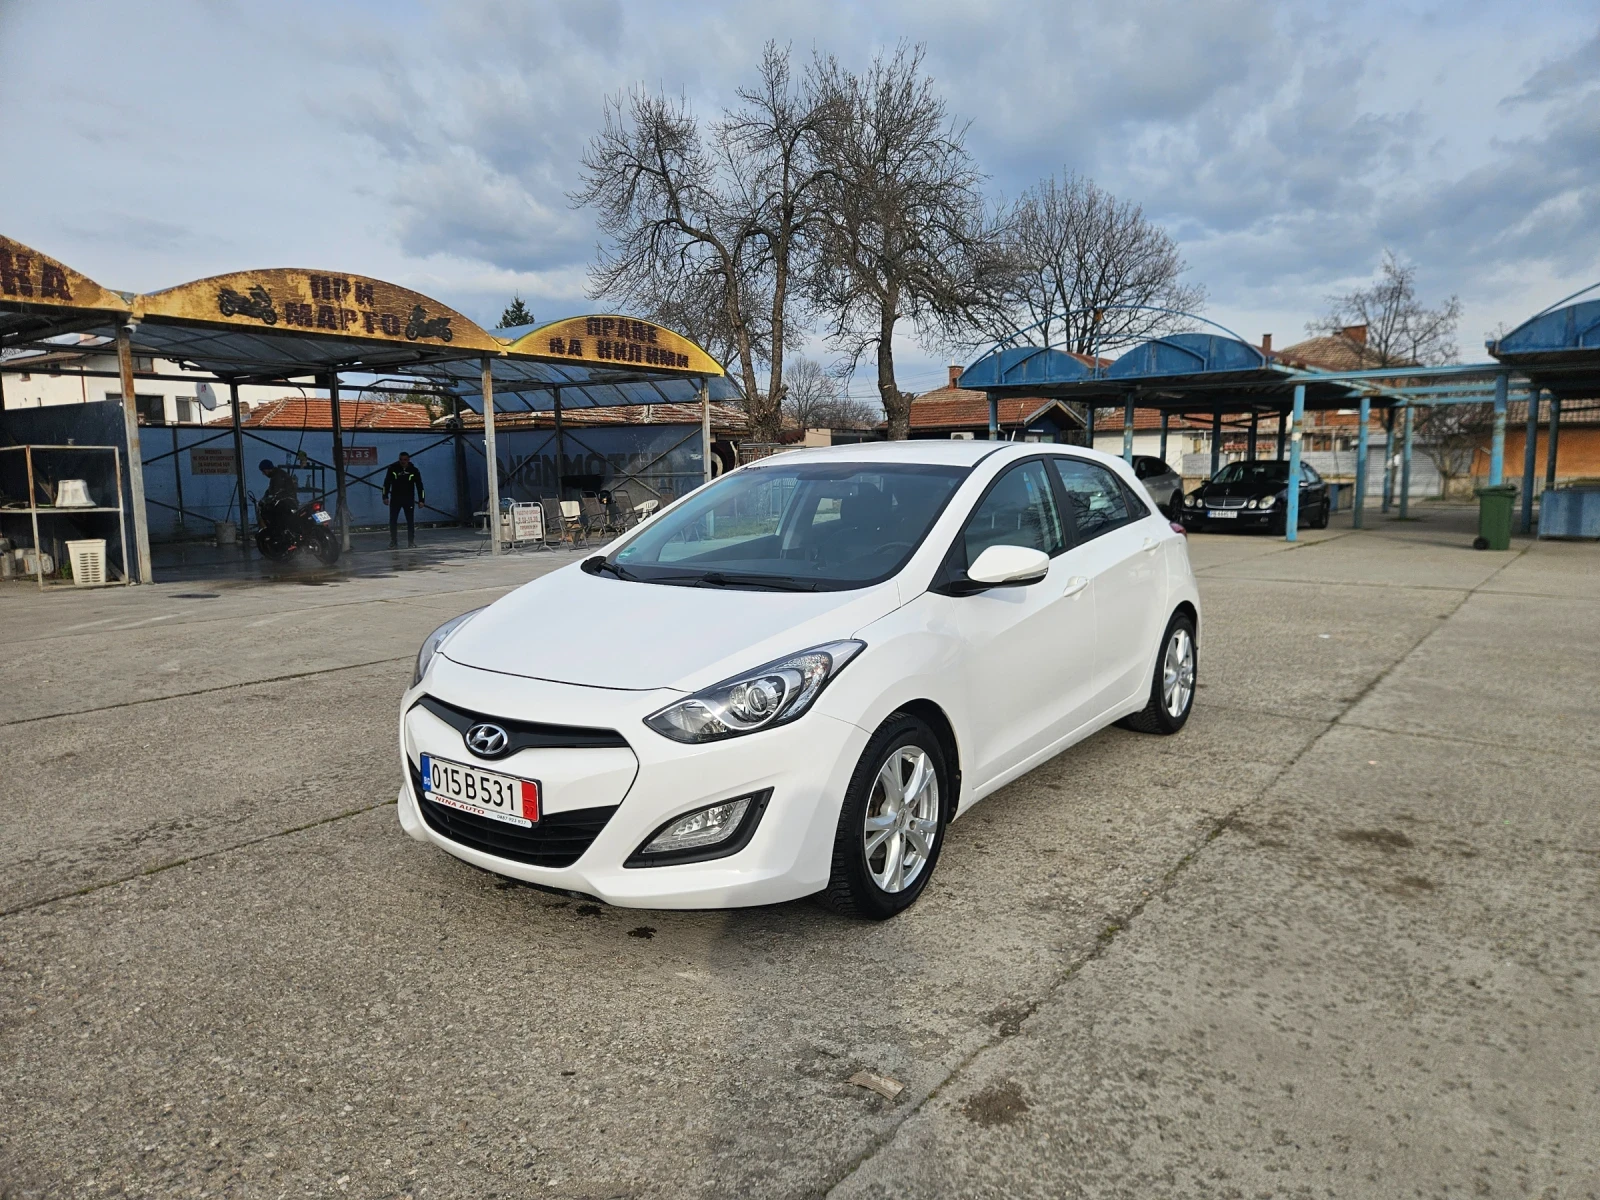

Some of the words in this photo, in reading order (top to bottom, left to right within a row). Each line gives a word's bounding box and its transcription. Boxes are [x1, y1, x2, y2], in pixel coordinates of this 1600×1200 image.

[310, 274, 374, 306] ПРИ
[285, 302, 401, 336] МАРТО
[586, 317, 658, 344] ПРАНЕ
[549, 336, 583, 357] НА
[597, 339, 689, 368] КИЛИМИ
[432, 763, 515, 811] 015B531
[435, 796, 457, 808] NINA
[459, 804, 485, 815] AUTO
